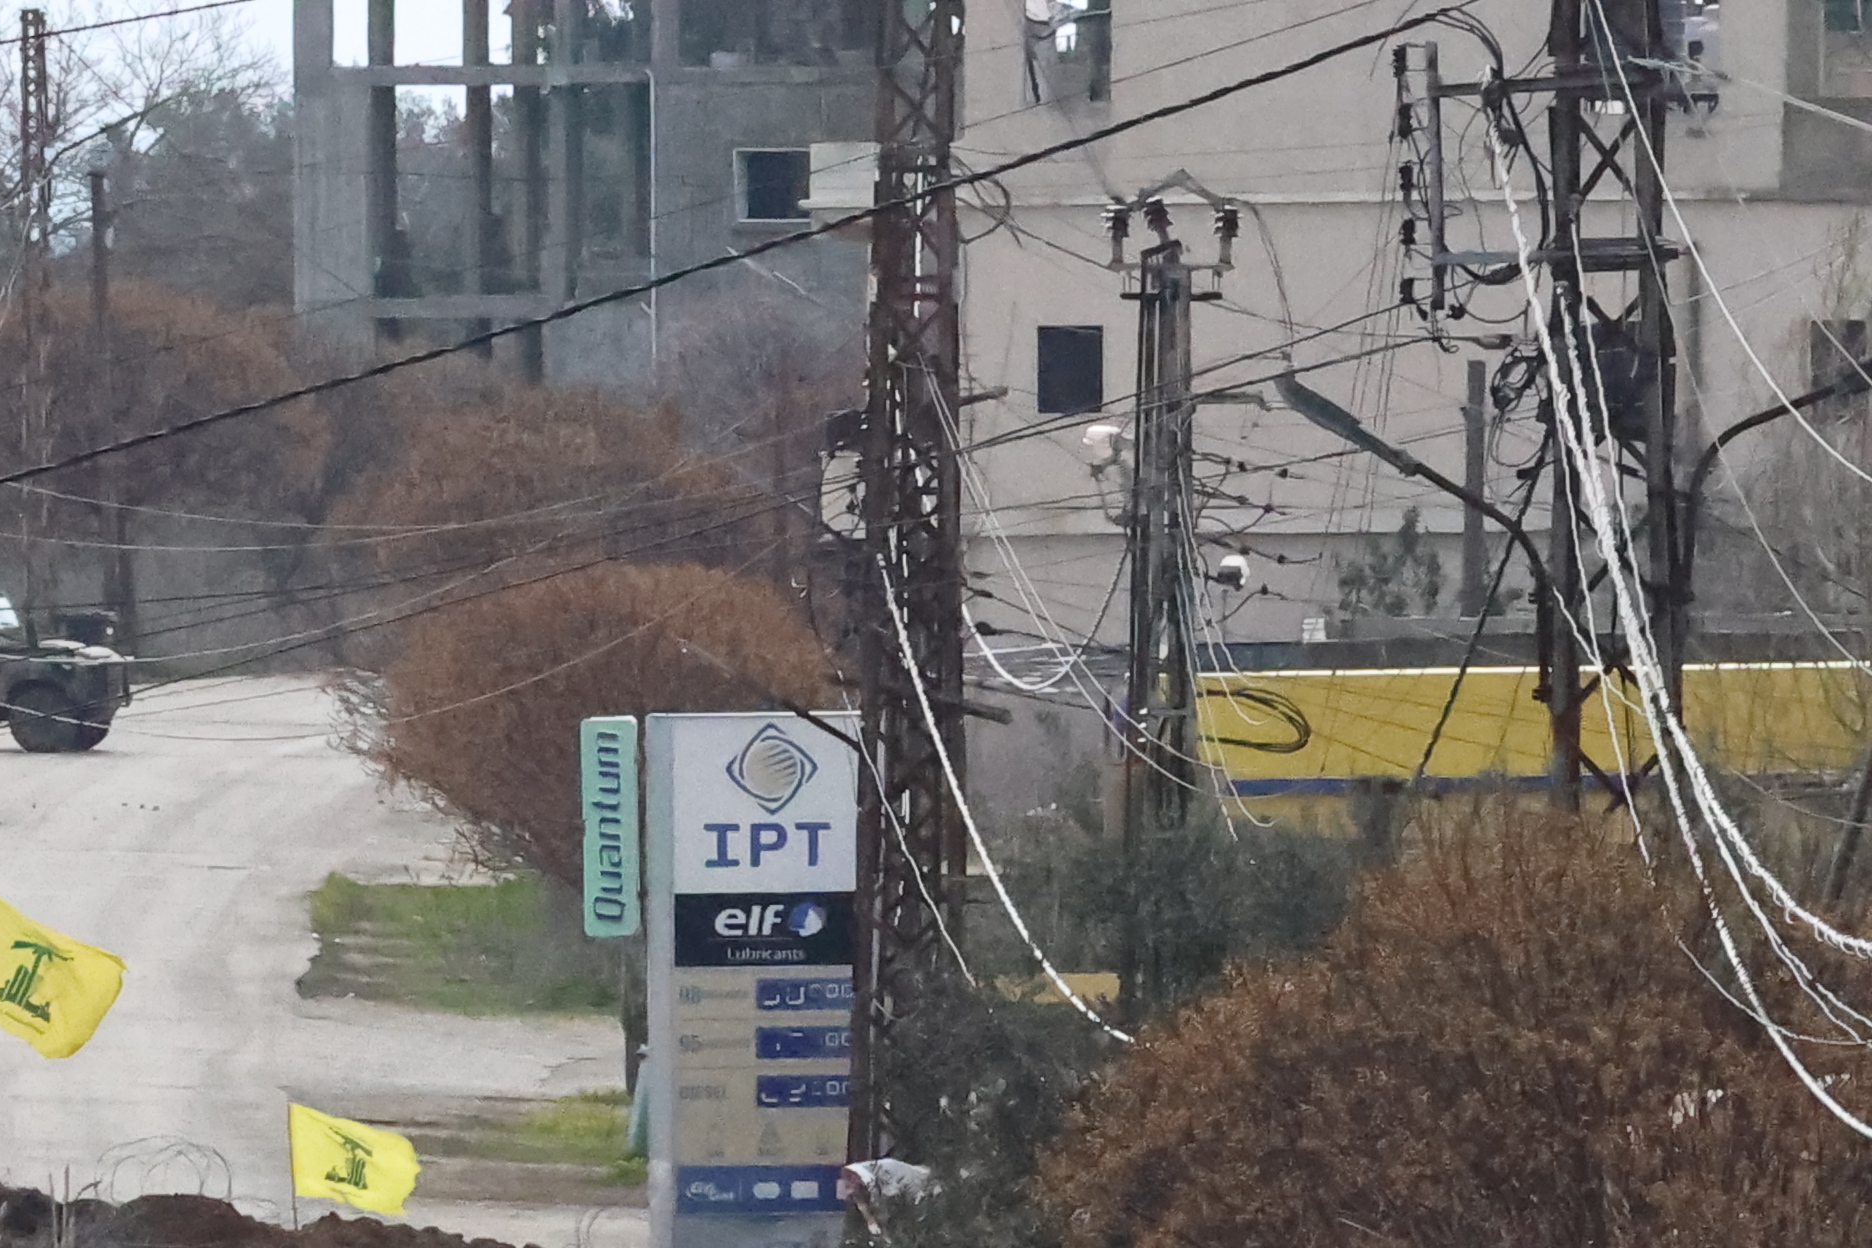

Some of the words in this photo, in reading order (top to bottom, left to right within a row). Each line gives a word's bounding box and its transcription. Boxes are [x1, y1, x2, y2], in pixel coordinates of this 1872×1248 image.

[592, 732, 626, 920] Quantum
[703, 822, 831, 868] IPT
[714, 904, 784, 936] elf
